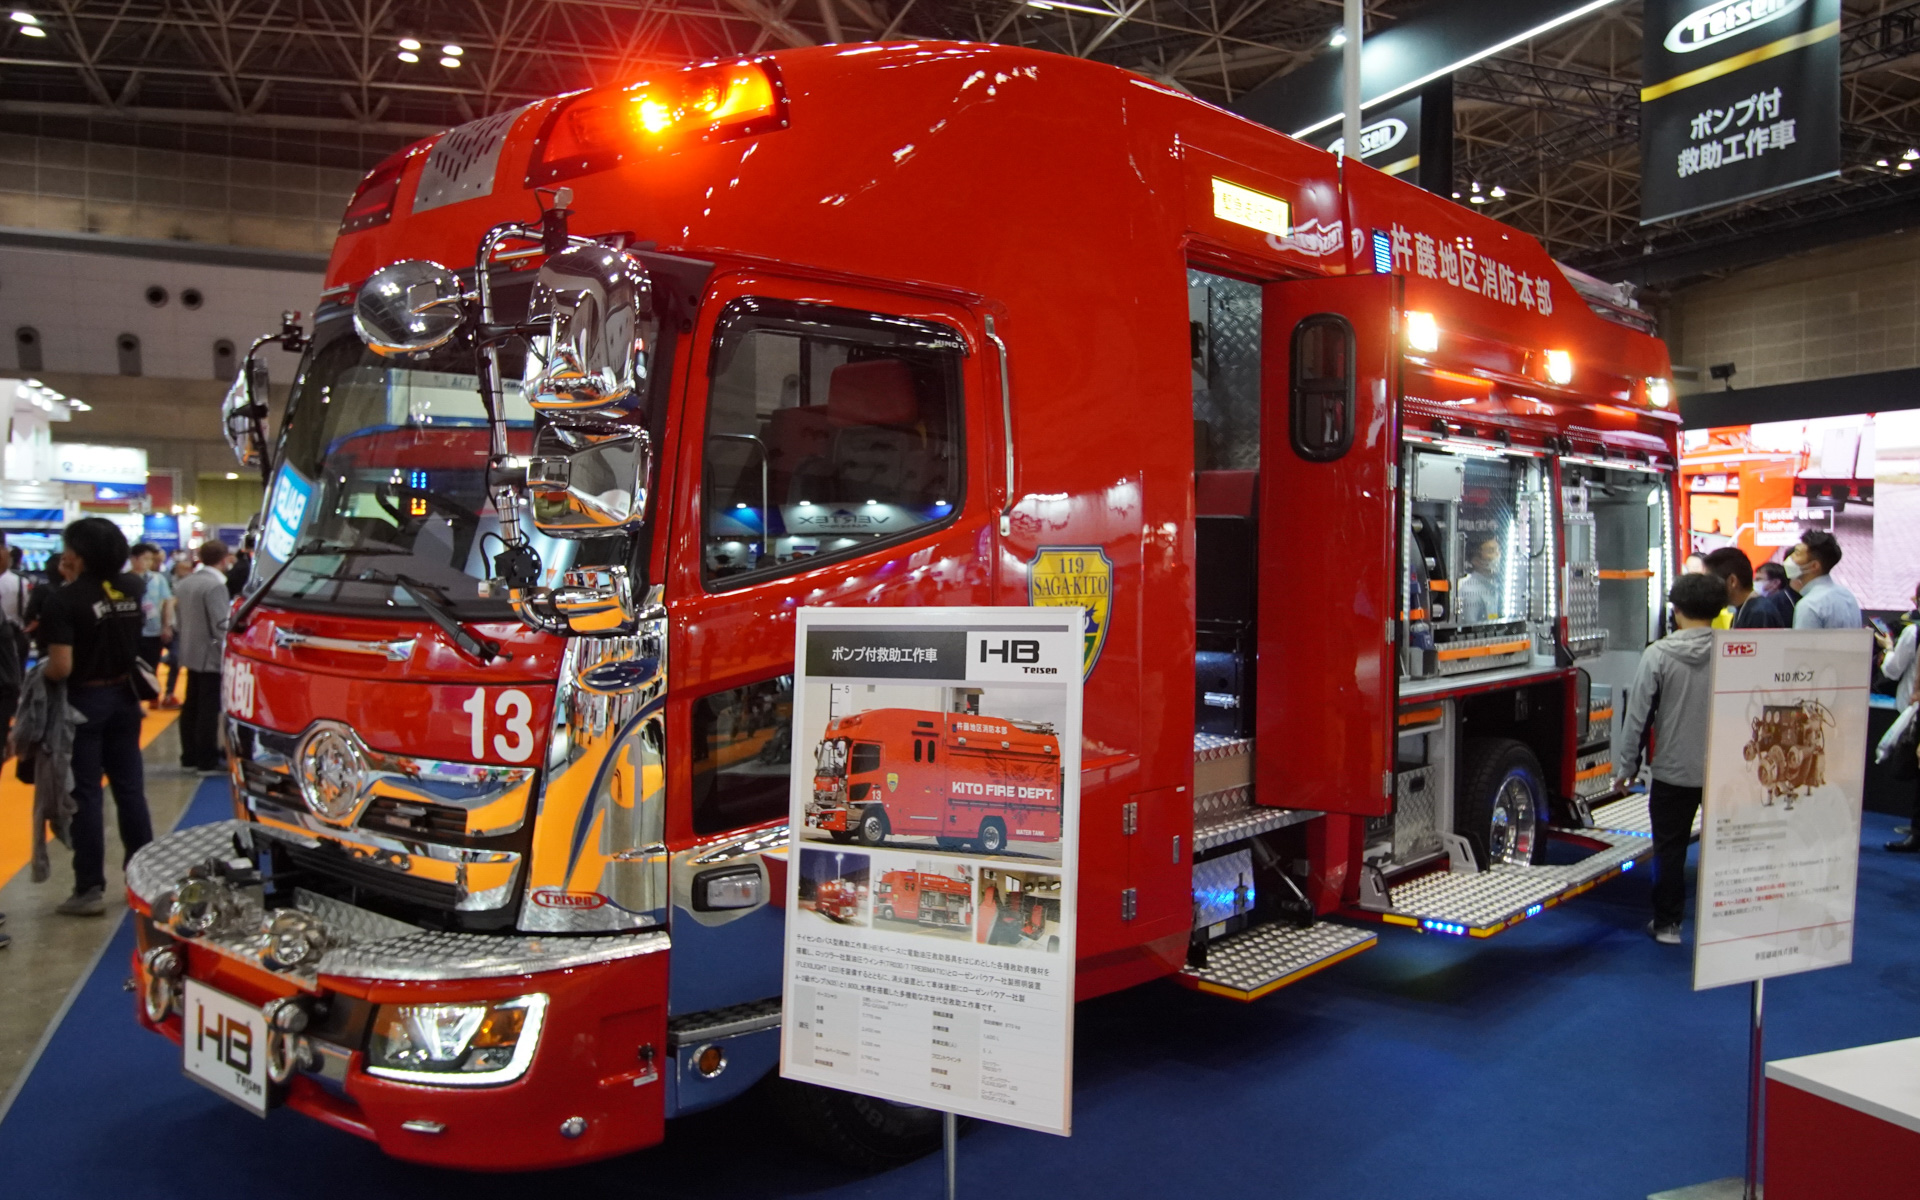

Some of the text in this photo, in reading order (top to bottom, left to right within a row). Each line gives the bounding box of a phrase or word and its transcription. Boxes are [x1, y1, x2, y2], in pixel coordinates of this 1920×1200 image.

[1690, 86, 1782, 141] ポンプ付
[1677, 118, 1796, 178] 救助工作車
[1391, 222, 1553, 317] 杵藤地区消防本部
[1059, 557, 1084, 574] 119
[1034, 575, 1108, 596] SAGA-KITO
[832, 646, 938, 663] ポンプ付救助工作車
[980, 640, 1040, 664] HB
[1727, 644, 1753, 654] テイセン
[1022, 666, 1058, 675] Teisen
[1774, 670, 1815, 683] N10 ポンプ
[463, 687, 534, 763] 13
[871, 789, 882, 800] 13
[952, 781, 1055, 801] KITO FIRE DEPT.
[543, 893, 593, 906] Teisen
[197, 1003, 254, 1075] HB
